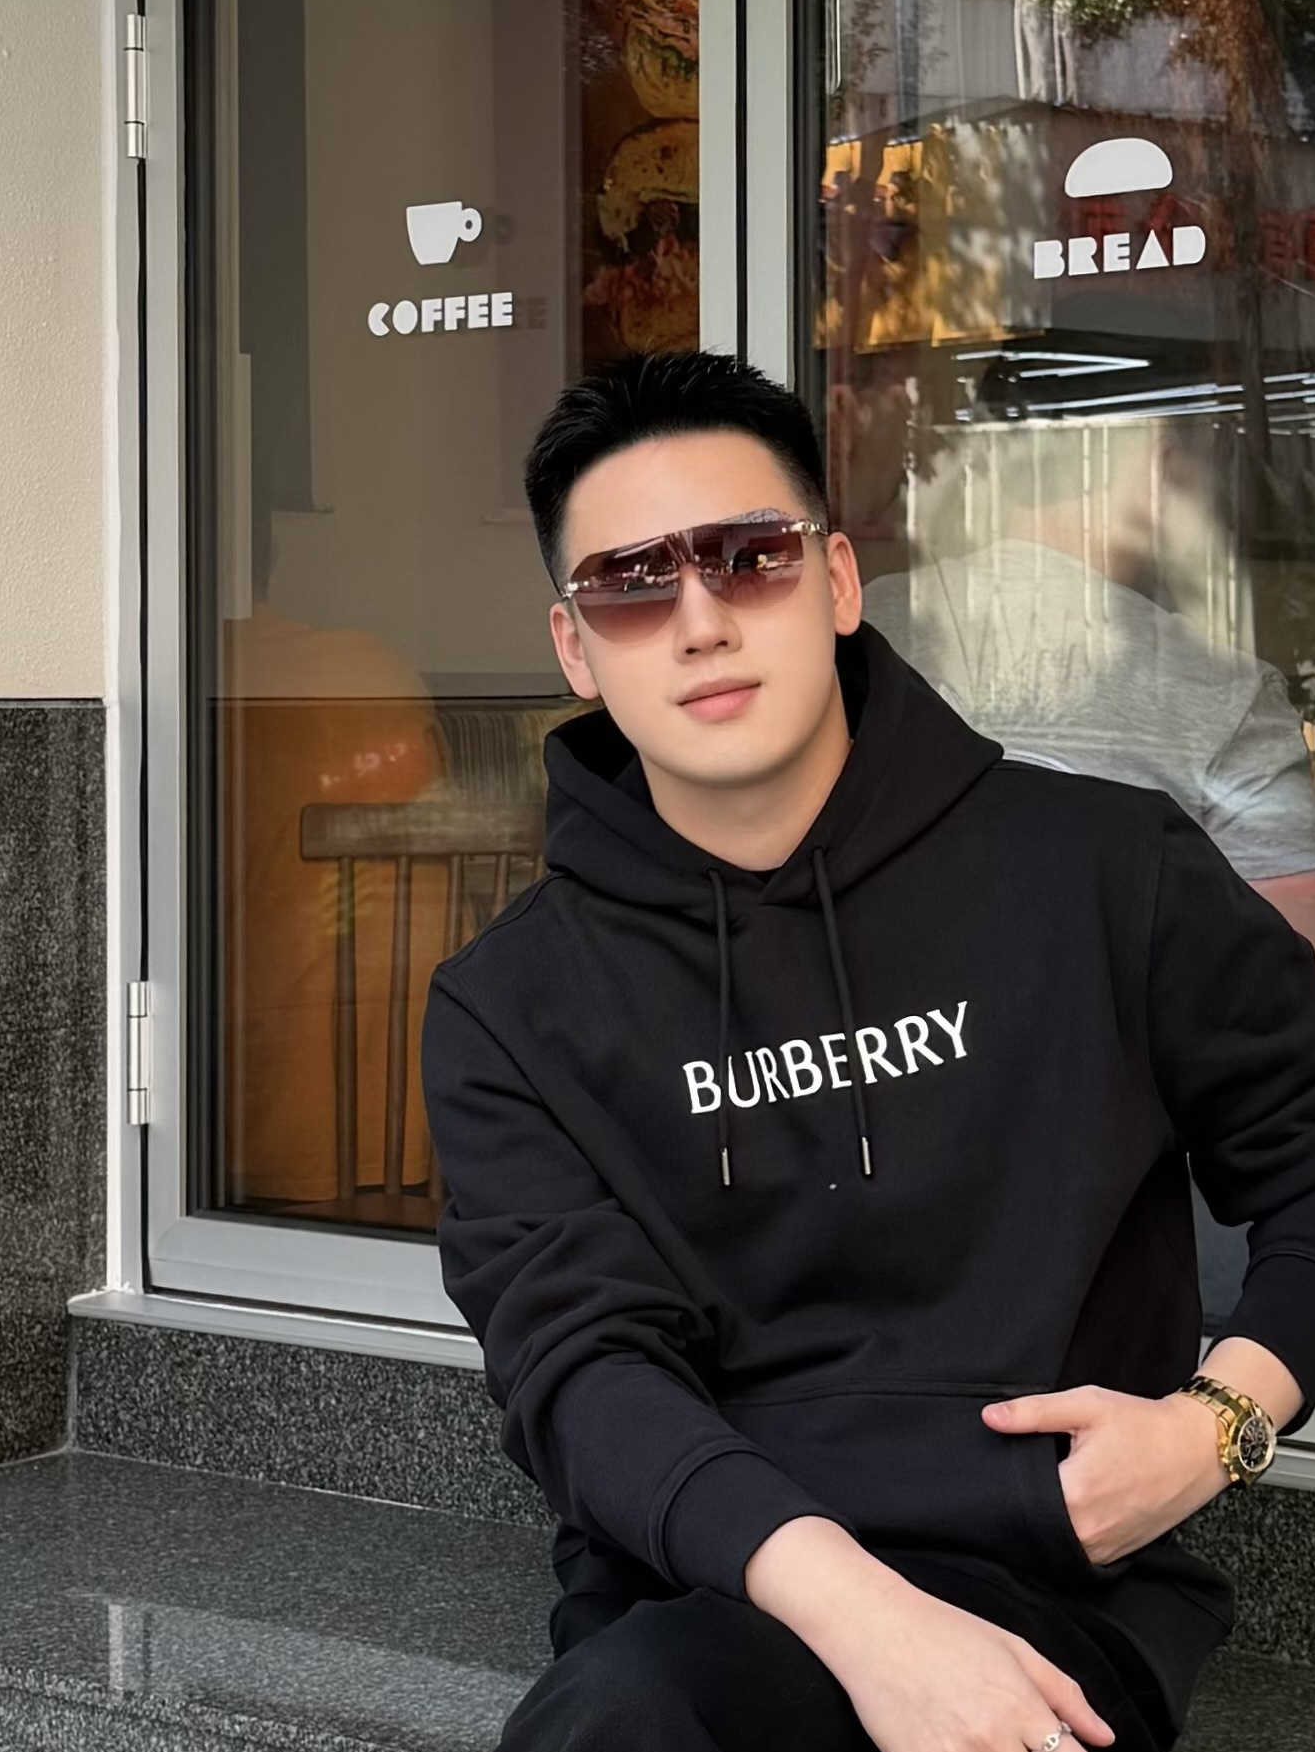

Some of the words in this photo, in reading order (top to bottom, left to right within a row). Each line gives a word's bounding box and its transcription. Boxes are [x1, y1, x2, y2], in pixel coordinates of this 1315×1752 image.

[1033, 225, 1206, 280] BREAD
[367, 291, 513, 337] COFFEE
[682, 1000, 969, 1114] BURBERRY
